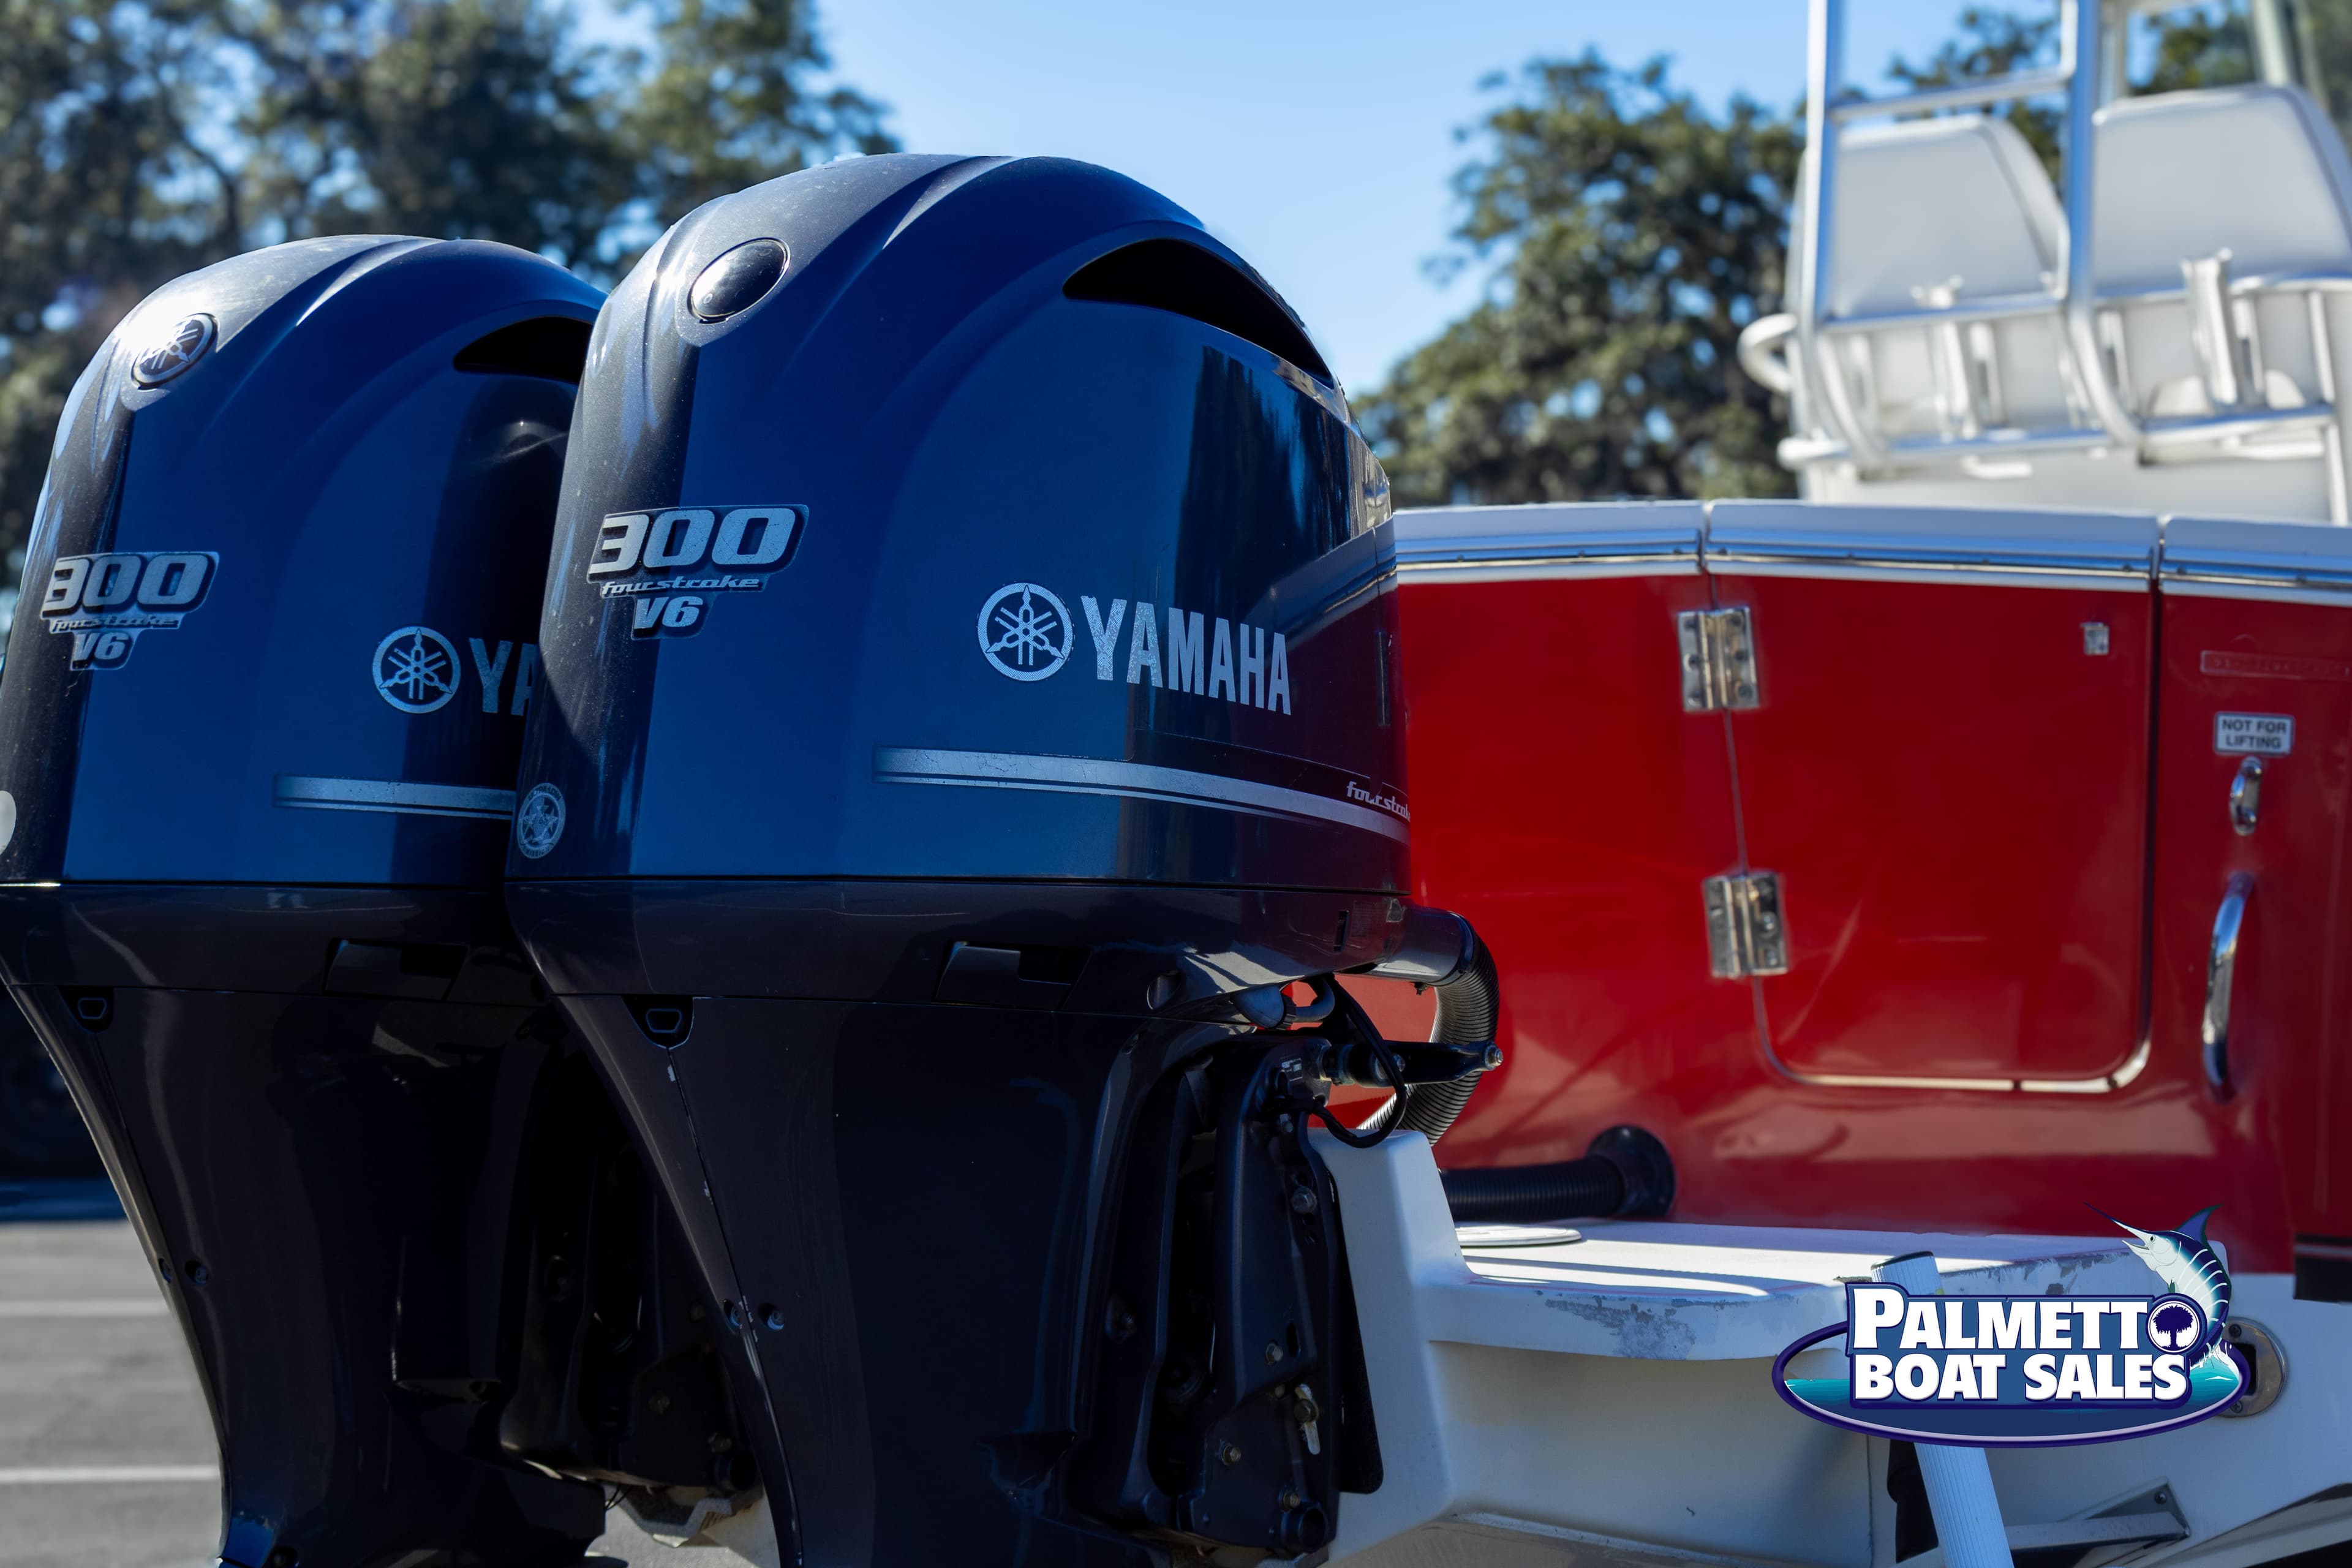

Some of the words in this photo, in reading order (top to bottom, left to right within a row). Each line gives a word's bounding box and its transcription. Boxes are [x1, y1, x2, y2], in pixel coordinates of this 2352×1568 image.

[589, 508, 796, 574] 300
[44, 555, 209, 611] 300
[634, 597, 703, 630] V6
[72, 632, 129, 660] V6
[1080, 595, 1291, 715] YAMAHA
[2222, 719, 2252, 731] NOT
[2257, 722, 2287, 734] FOR
[2226, 736, 2282, 749] LIFTING
[1347, 781, 1411, 823] fourstrok
